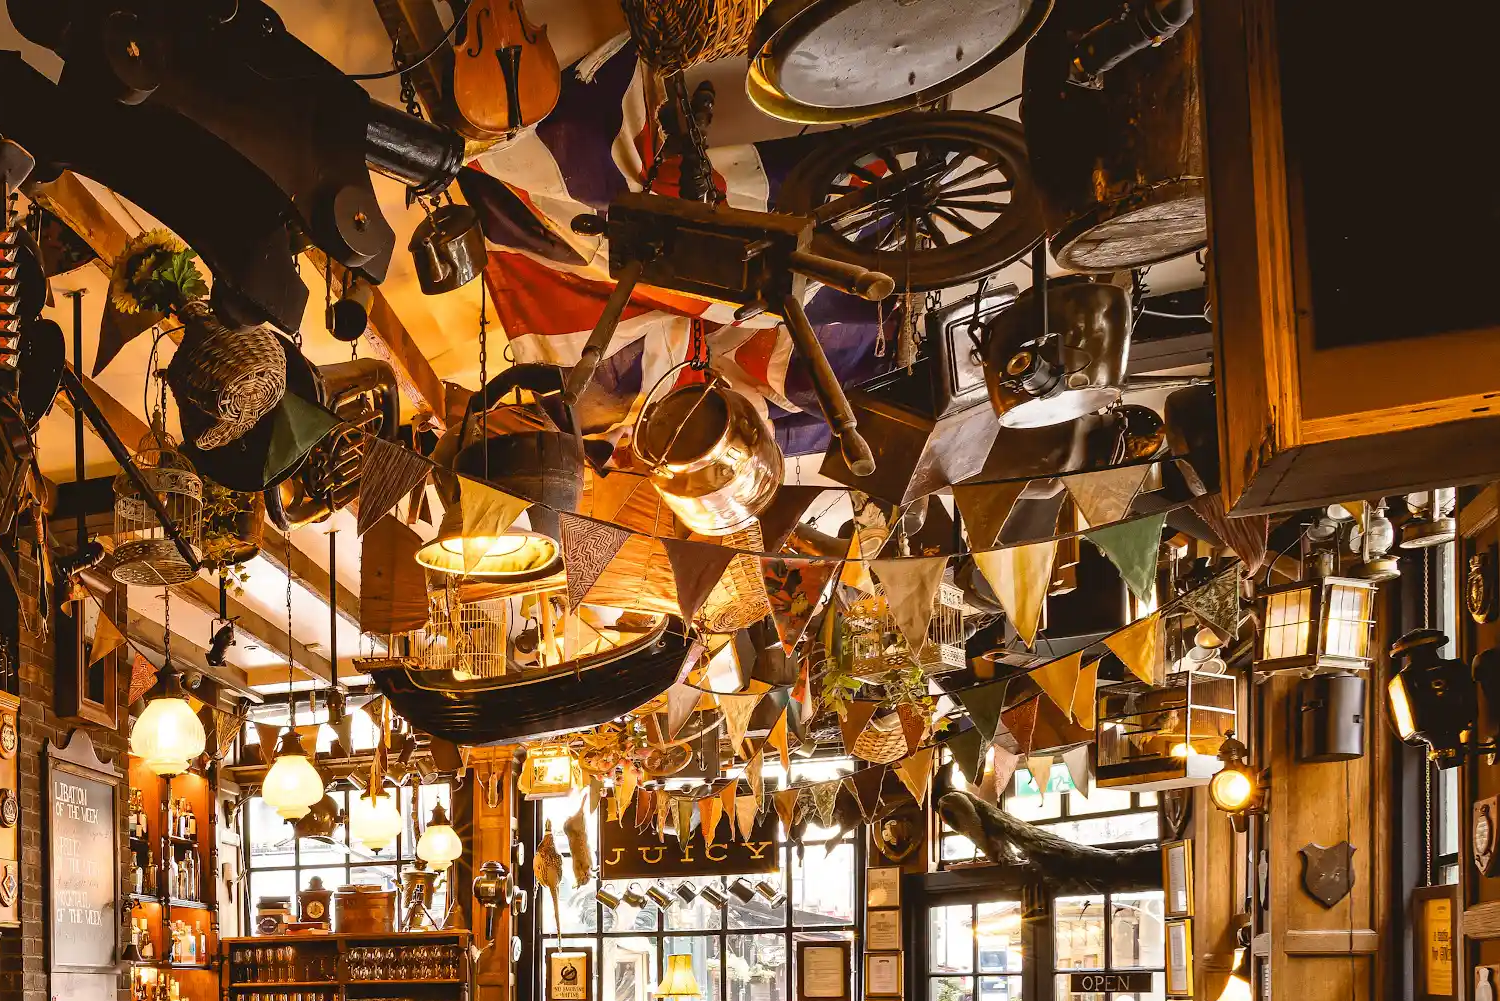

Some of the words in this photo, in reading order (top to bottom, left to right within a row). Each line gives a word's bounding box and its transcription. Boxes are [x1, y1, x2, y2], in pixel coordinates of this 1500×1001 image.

[54, 781, 88, 807] LIBATION
[55, 801, 64, 817] OF
[66, 803, 80, 820] THE
[80, 806, 100, 825] WEEK
[604, 841, 773, 866] JUICY
[56, 908, 65, 923] OF
[68, 908, 83, 924] THE
[1082, 975, 1130, 991] OPEN
